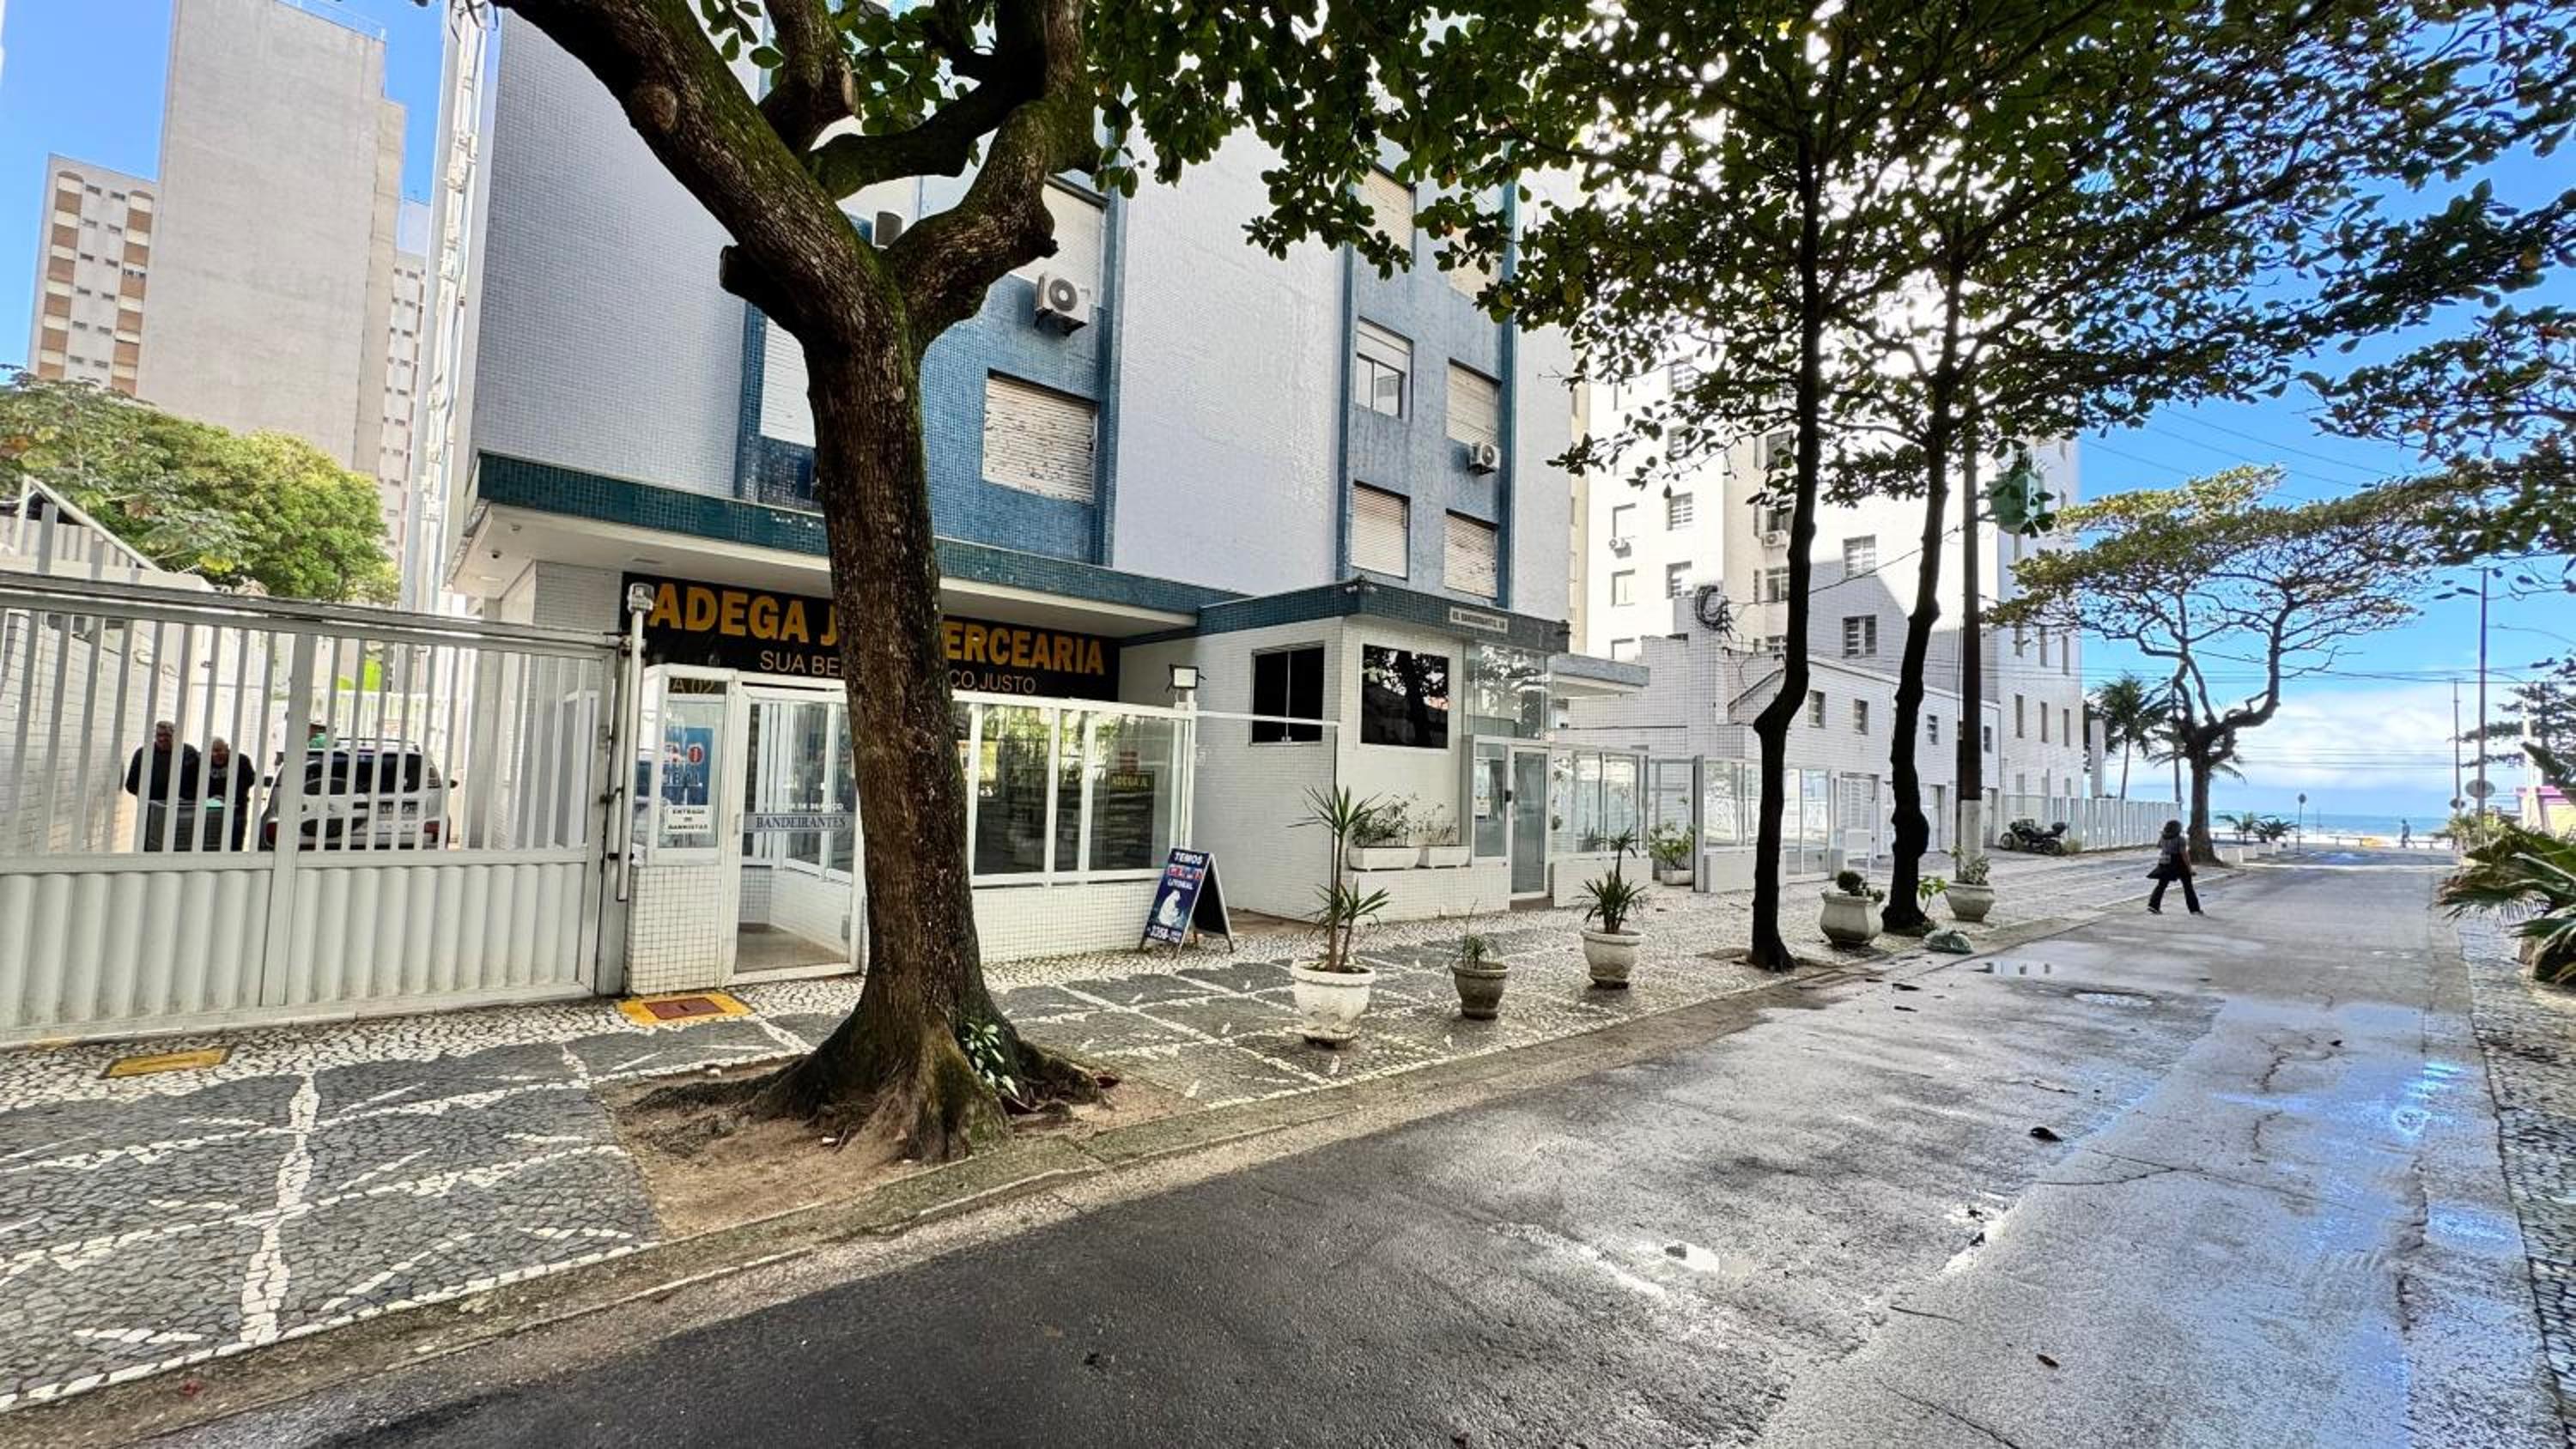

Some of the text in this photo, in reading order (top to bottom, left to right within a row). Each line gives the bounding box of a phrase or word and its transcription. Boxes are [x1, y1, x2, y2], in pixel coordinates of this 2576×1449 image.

[648, 583, 1105, 676] ADEGA J ERCEARIA
[760, 650, 806, 674] SUA
[811, 655, 845, 677] BE
[979, 672, 1037, 694] JUSTO
[756, 816, 846, 829] BANDEIRANTES
[1175, 852, 1203, 865] TEMOS
